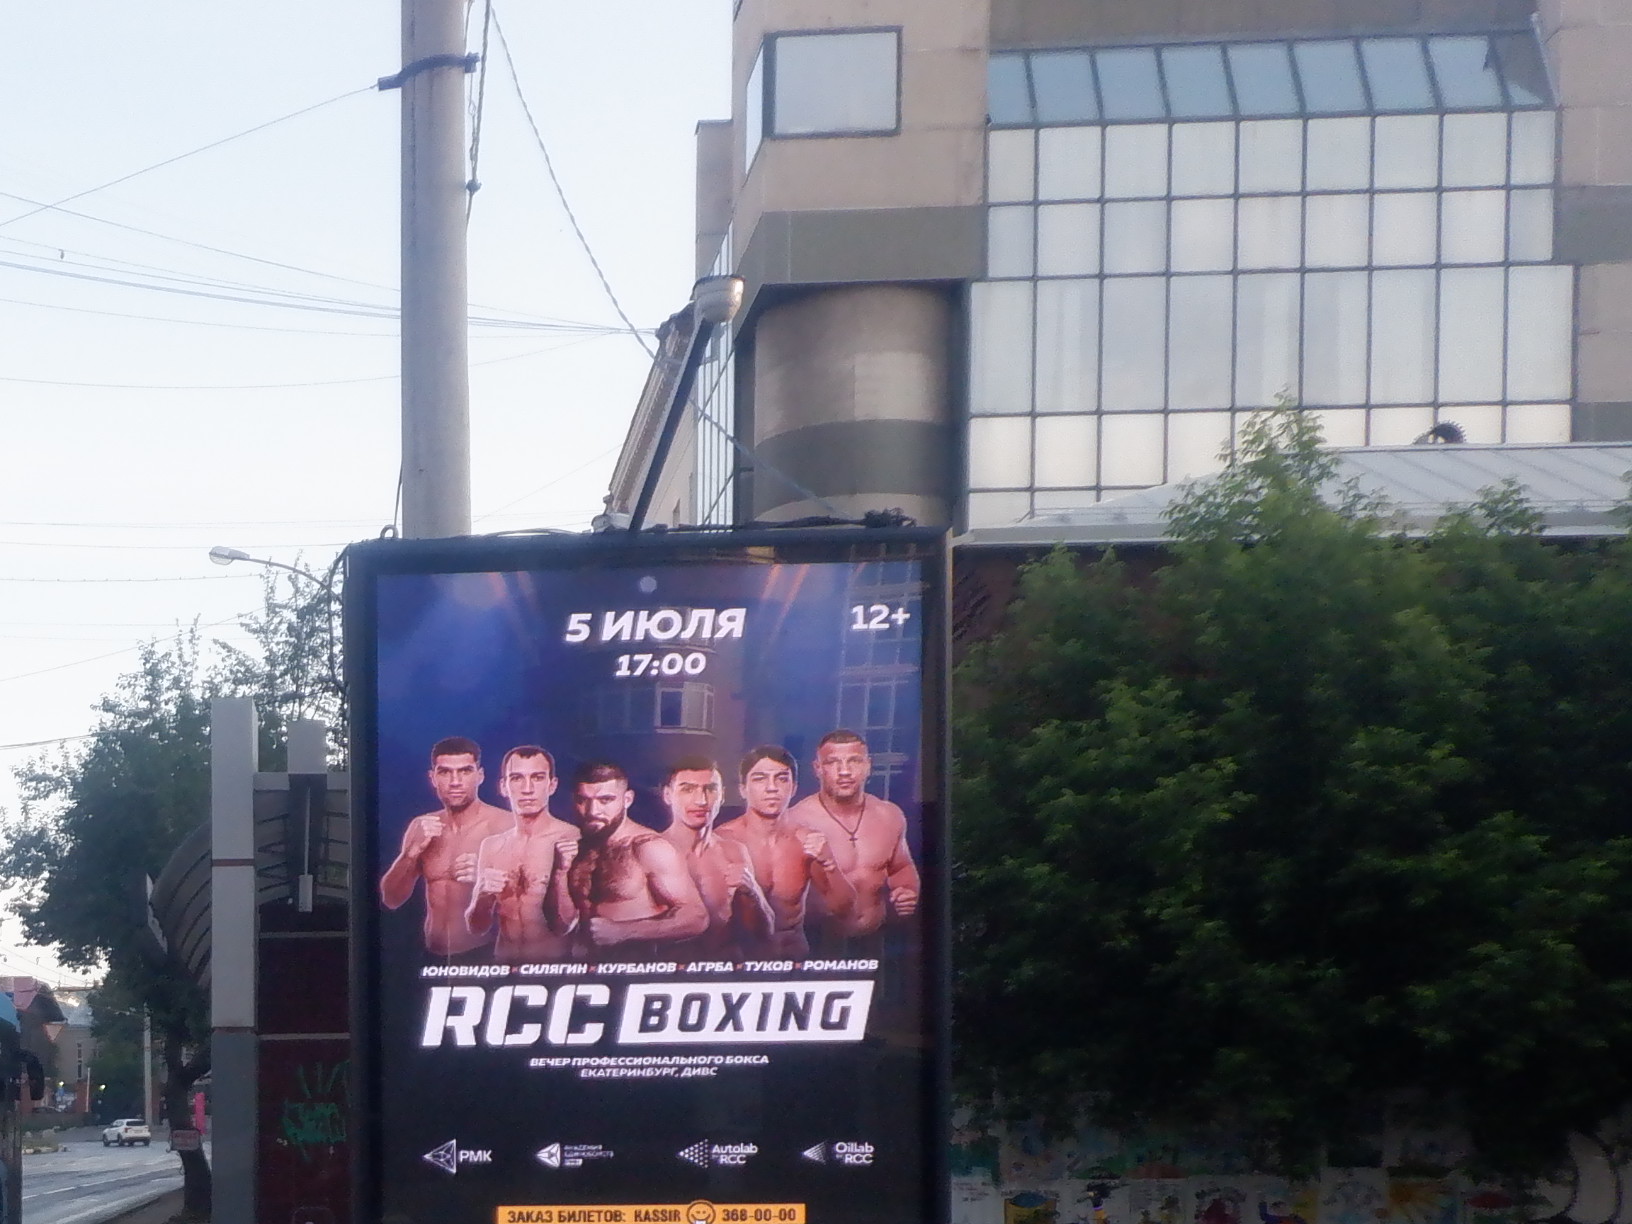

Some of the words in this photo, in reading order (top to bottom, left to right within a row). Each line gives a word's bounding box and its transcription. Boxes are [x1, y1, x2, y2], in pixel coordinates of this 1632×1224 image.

[851, 604, 910, 630] 12+
[566, 613, 592, 642] 5
[602, 608, 746, 642] ИЮЛЯ
[615, 652, 706, 677] 17:00
[422, 965, 510, 978] ЮНОВИДОВ
[520, 963, 588, 975] СИЛЯГИН
[598, 962, 677, 974] КУРБАНОВ
[686, 961, 734, 972] АГРБА
[745, 960, 793, 972] ТУКОВ
[803, 959, 879, 971] РОМАНОВ
[422, 984, 611, 1046] RCC
[639, 991, 855, 1033] BOXING
[530, 1057, 571, 1067] ВЕЧЕР
[572, 1055, 724, 1066] ПРОФЕССИОНАЛЬНОГО
[725, 1055, 769, 1064] БОКСА
[580, 1067, 679, 1078] ЕКАТЕРИНБУРГ,
[681, 1066, 718, 1077] ДИВС
[712, 1142, 758, 1153] Autolab
[459, 1150, 492, 1162] РМК
[720, 1154, 746, 1164] RCC
[844, 1153, 873, 1164] RCC
[507, 1211, 553, 1223] ЗАКАЗ
[557, 1210, 626, 1223] БИЛЕТОВ:
